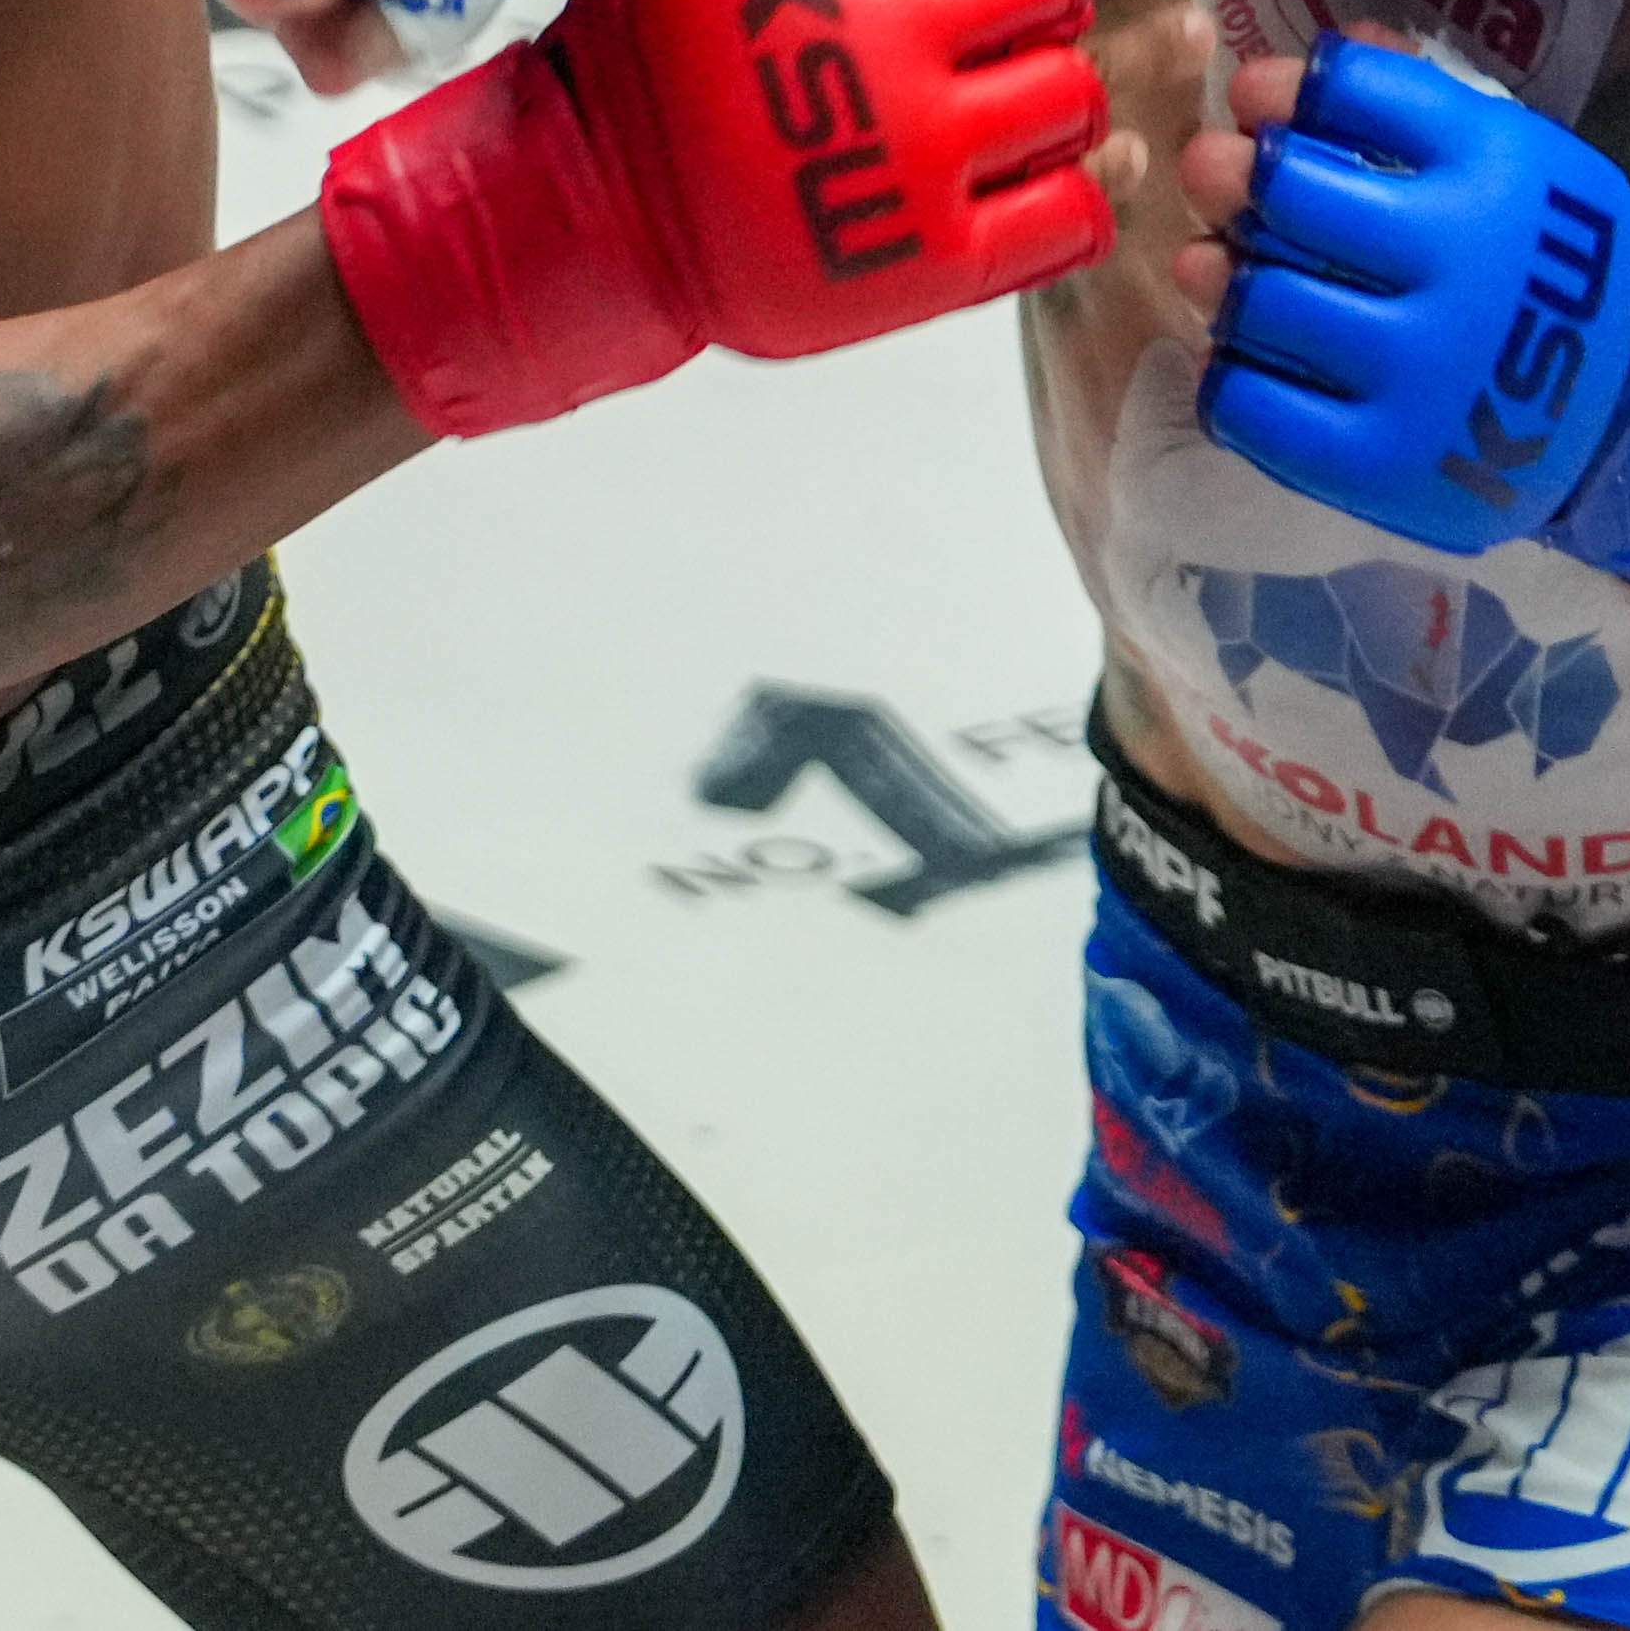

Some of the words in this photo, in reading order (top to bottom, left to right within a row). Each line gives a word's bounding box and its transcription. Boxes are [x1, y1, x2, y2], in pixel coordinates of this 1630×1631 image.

[1441, 184, 1617, 510] KSW
[24, 725, 321, 997] KSWAPP
[64, 875, 250, 1011] WELISSON
[1253, 950, 1408, 1025] PITBULL
[14, 1189, 195, 1316] DA
[186, 981, 463, 1205] TOPIC
[357, 1128, 523, 1248] NATURAL
[390, 1148, 556, 1275] SPARTAN
[1085, 1436, 1298, 1569] NEMESIS
